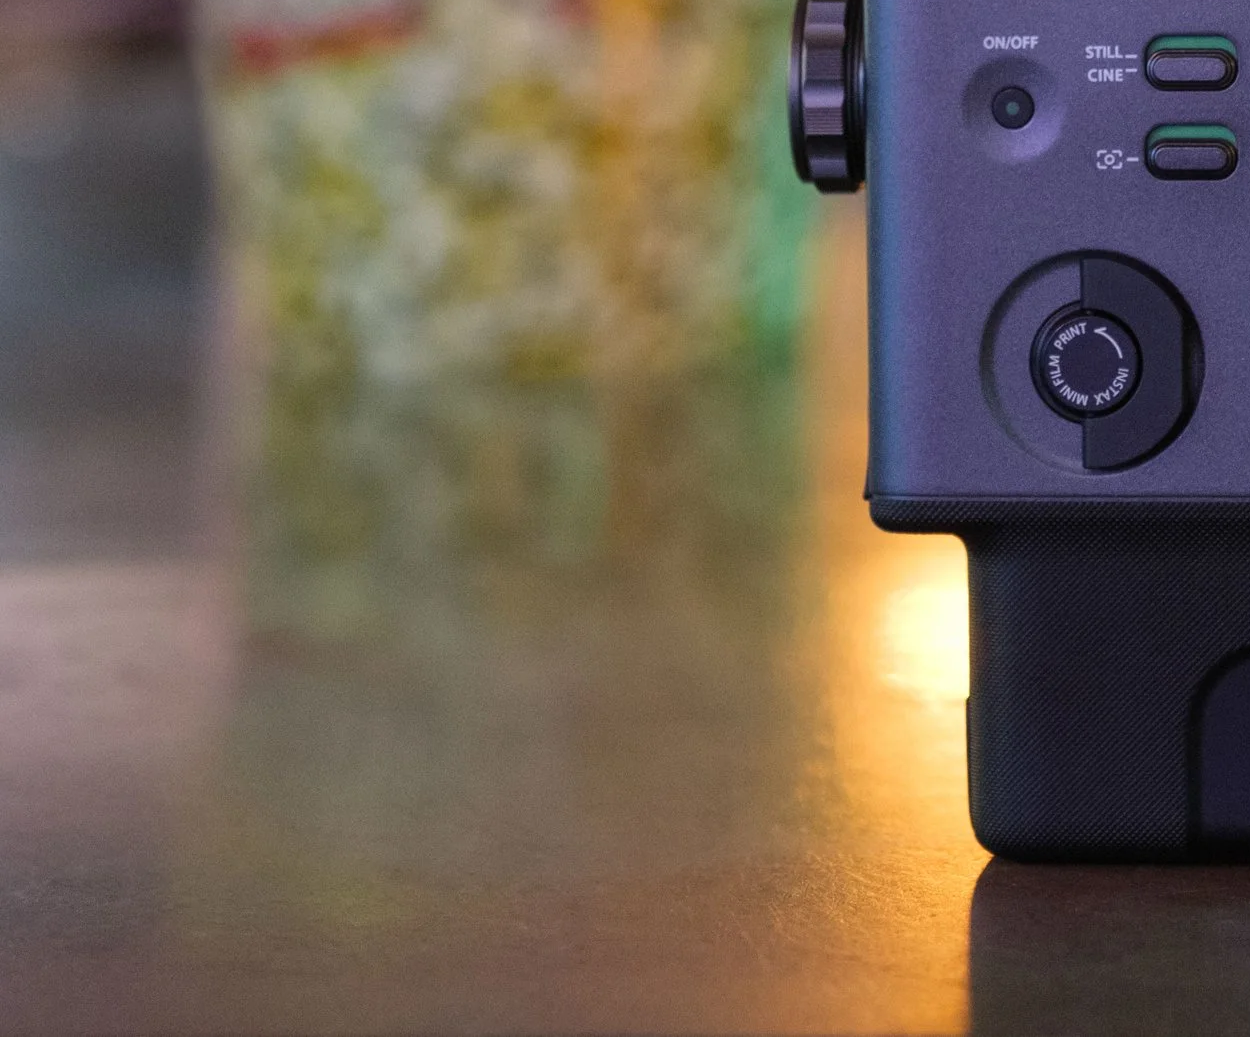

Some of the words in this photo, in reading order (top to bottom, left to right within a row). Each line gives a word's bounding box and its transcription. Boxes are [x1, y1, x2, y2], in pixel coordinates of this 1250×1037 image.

[983, 36, 1039, 49] ON/OFF
[1085, 46, 1123, 59] STILL
[1088, 69, 1124, 82] CINE
[1053, 323, 1087, 350] PRINT
[1048, 354, 1064, 387] FILM
[1059, 384, 1089, 406] MINI
[1094, 368, 1130, 406] INSTAX
